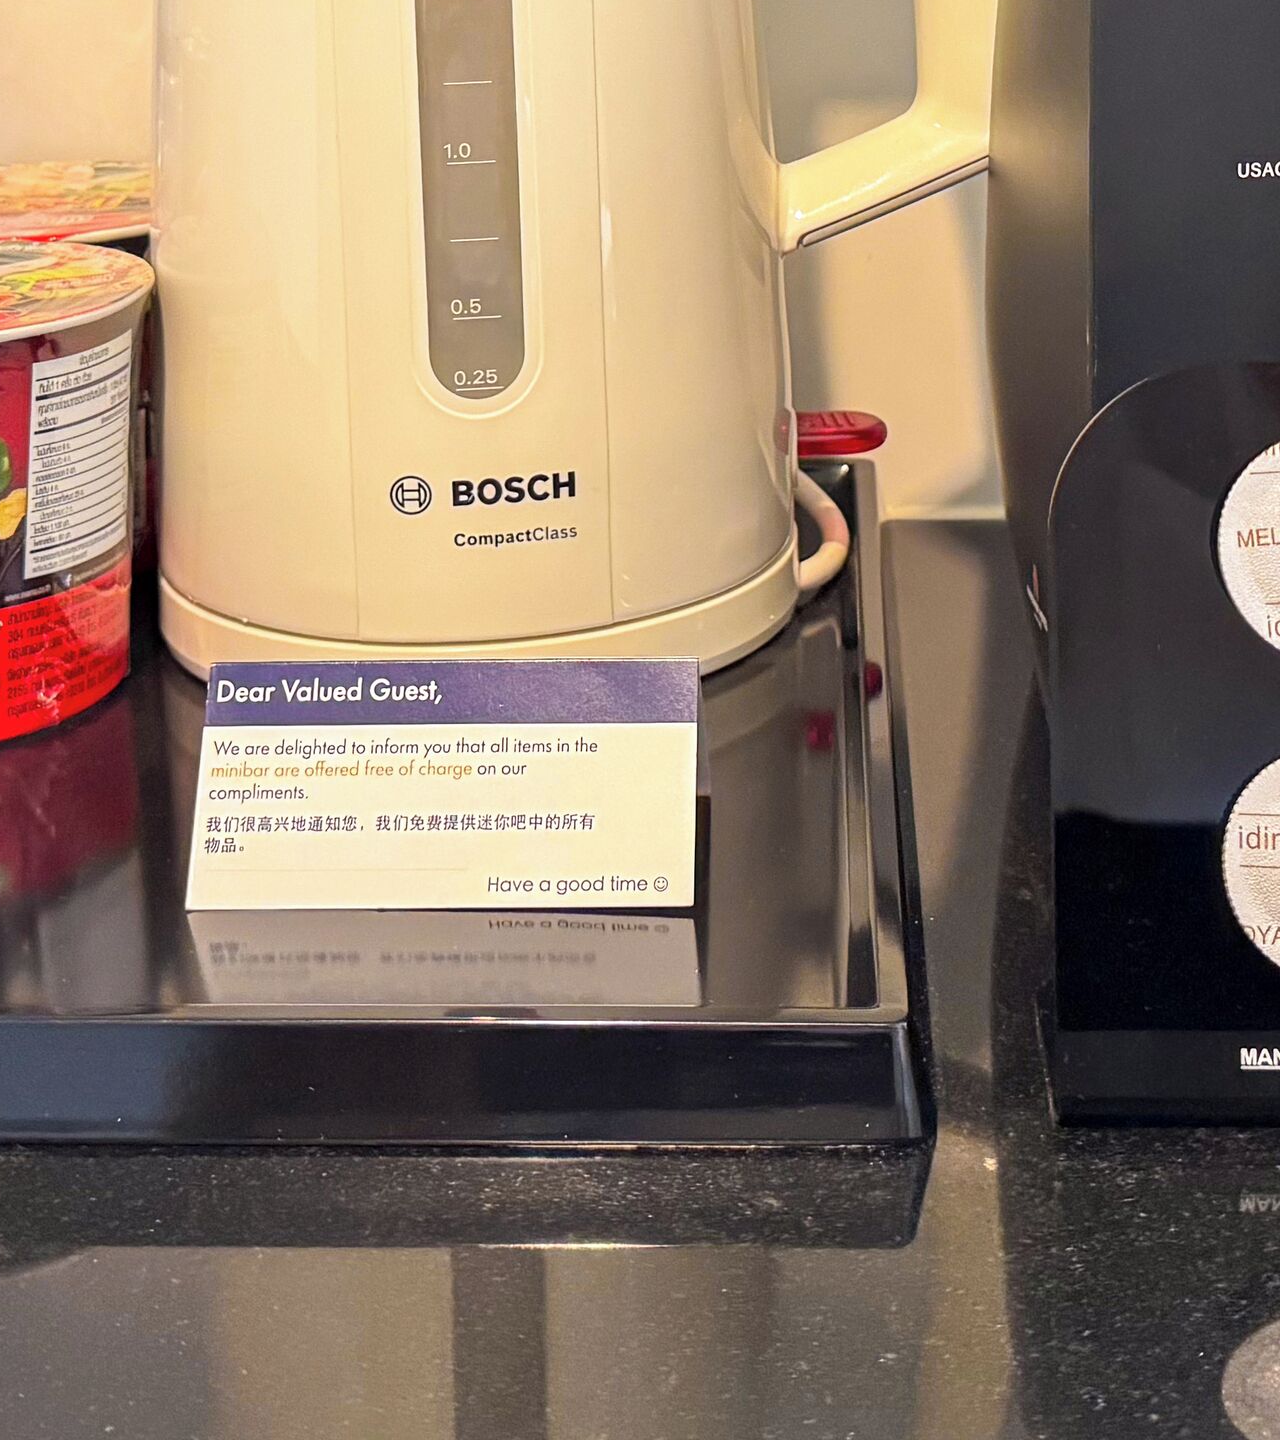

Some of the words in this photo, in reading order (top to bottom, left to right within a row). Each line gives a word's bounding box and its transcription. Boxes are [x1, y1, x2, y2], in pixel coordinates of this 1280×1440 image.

[443, 143, 471, 159] 1.0
[450, 298, 481, 315] 0.5
[454, 369, 498, 385] 0.25
[451, 471, 576, 506] BOSCH
[454, 526, 577, 547] CompactClass
[216, 679, 276, 703] Dear
[281, 677, 363, 702] Valued
[369, 678, 443, 704] Guest,
[213, 740, 240, 755] We
[244, 744, 270, 755] are
[274, 738, 347, 759] delighted
[352, 740, 366, 755] to
[371, 737, 419, 754] inform
[424, 743, 451, 758] you
[456, 737, 486, 753] that
[490, 737, 509, 753] all
[513, 738, 552, 753] items
[557, 738, 570, 753] in
[575, 737, 598, 753] the
[211, 761, 270, 778] minibar
[274, 766, 299, 777] are
[304, 760, 359, 777] offered
[365, 760, 394, 777] free
[398, 759, 415, 776] of
[419, 760, 472, 780] charge
[477, 765, 496, 775] on
[501, 764, 527, 775] our
[209, 783, 309, 804] compliments.
[204, 837, 245, 854] 物品。
[487, 877, 534, 893] Have
[539, 880, 551, 892] a
[556, 876, 604, 895] good
[610, 876, 648, 892] time
